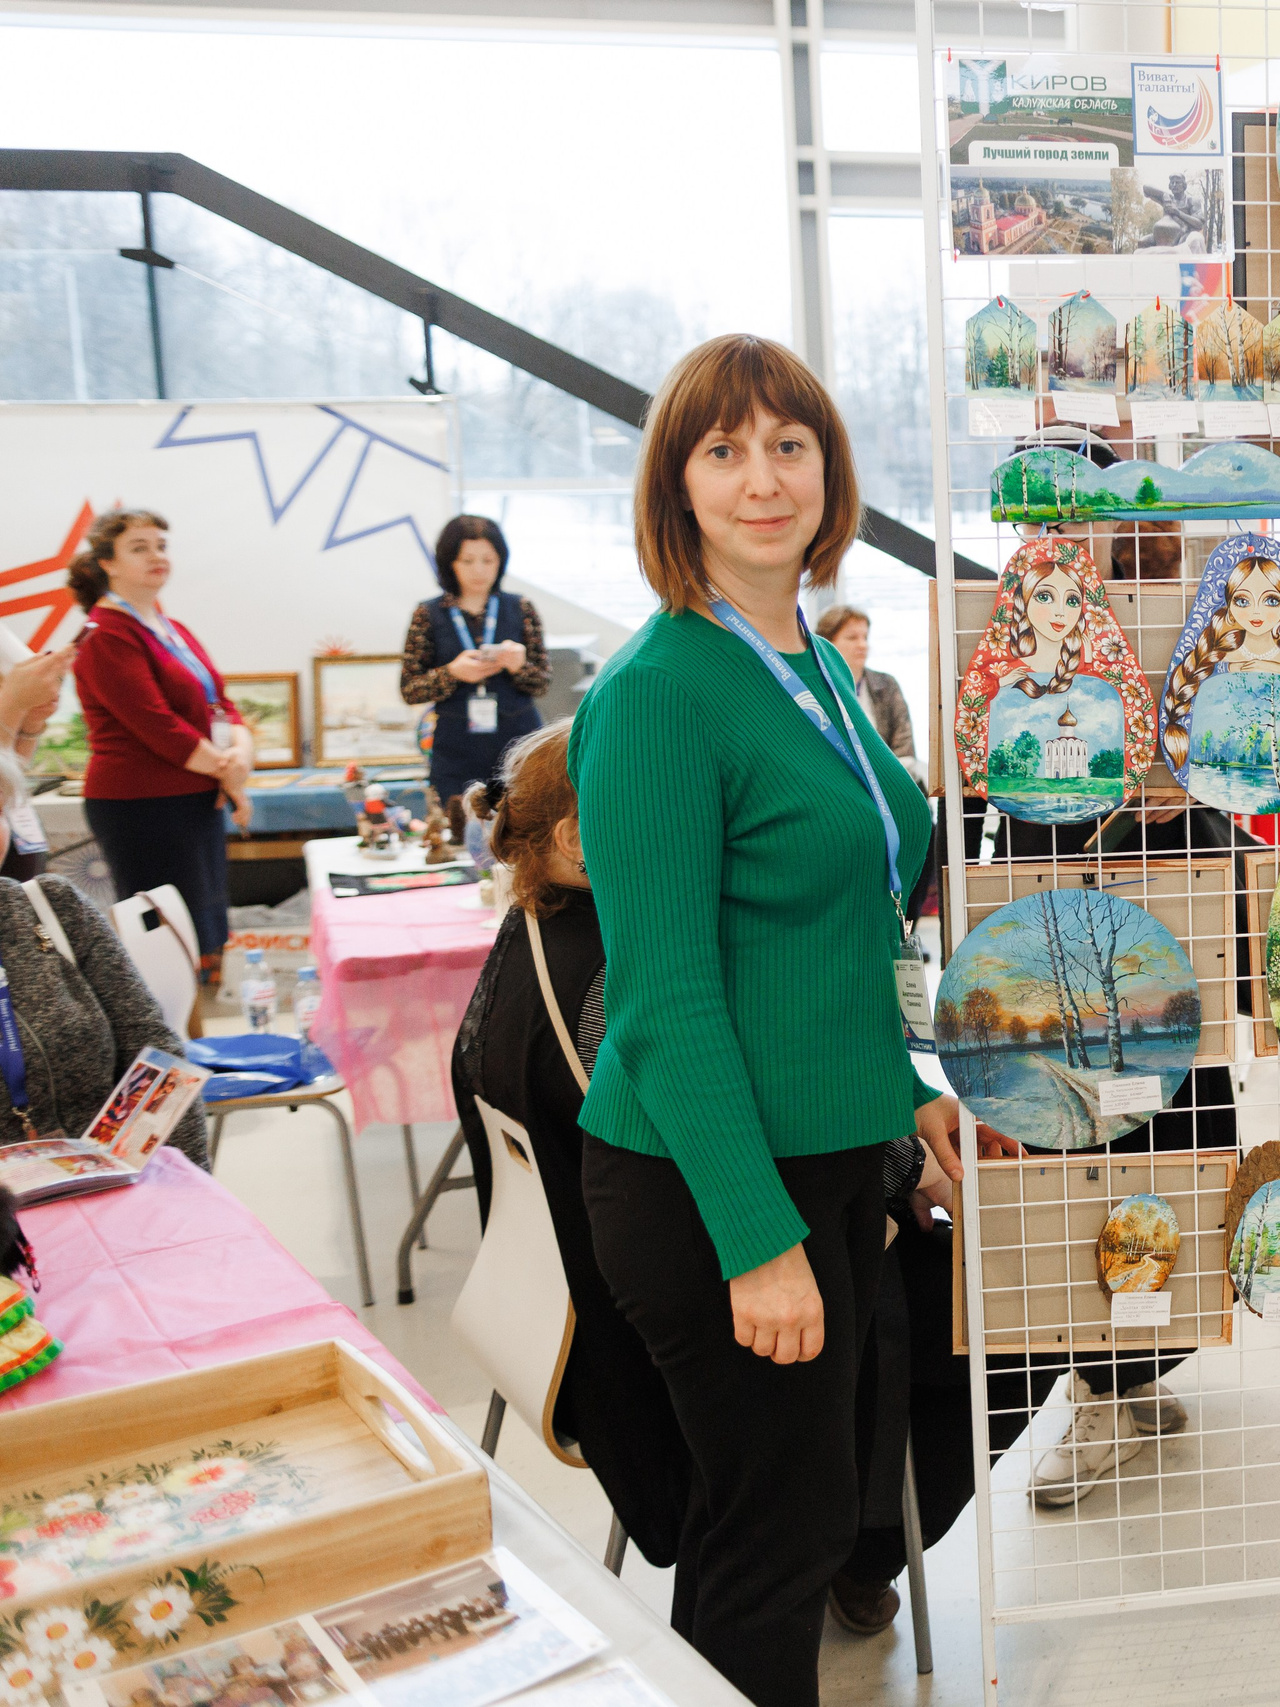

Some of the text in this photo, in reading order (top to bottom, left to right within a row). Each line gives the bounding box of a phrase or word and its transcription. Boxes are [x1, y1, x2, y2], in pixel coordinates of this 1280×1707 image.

[1011, 74, 1108, 92] КИРОВ
[1137, 70, 1179, 85] Виват,
[1137, 82, 1196, 94] таланты!
[1012, 97, 1119, 111] КАЛУЖСКАЯ ОБЛАСТЬ
[982, 146, 1110, 162] Лучший город земли
[725, 613, 767, 652] таланты!
[766, 649, 792, 682] Виват,
[854, 743, 890, 816] Виват, таланты!
